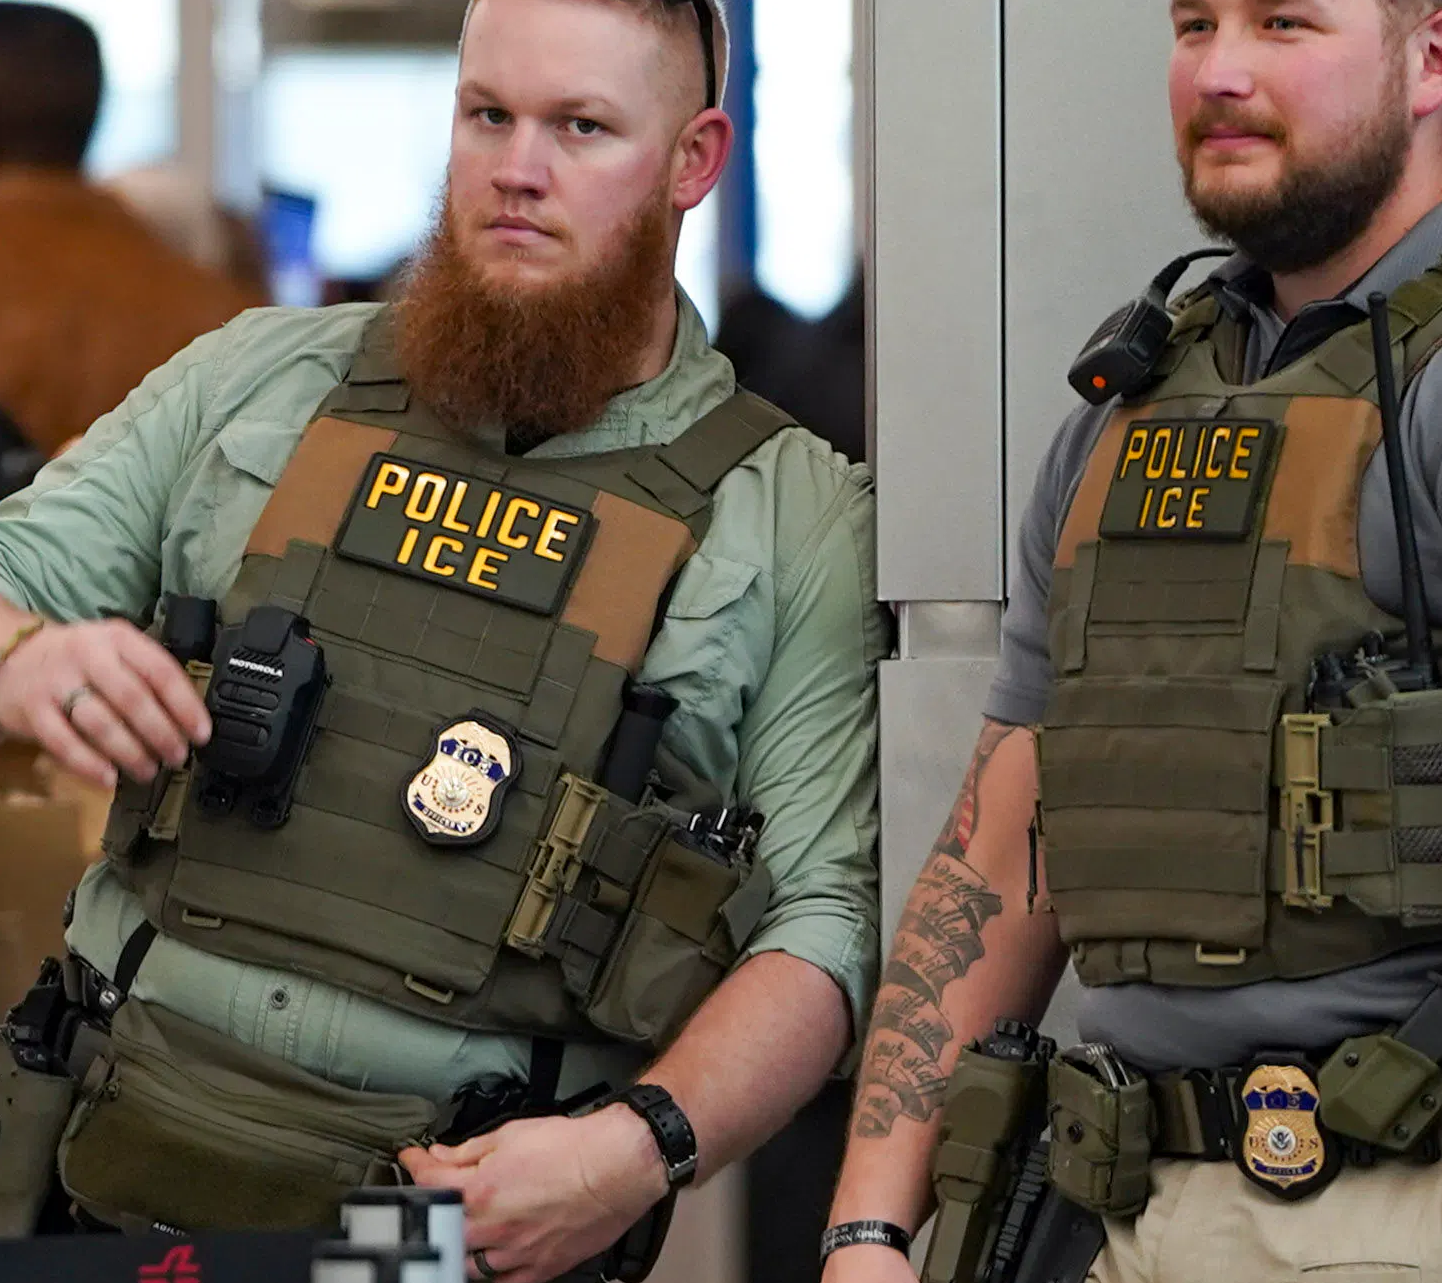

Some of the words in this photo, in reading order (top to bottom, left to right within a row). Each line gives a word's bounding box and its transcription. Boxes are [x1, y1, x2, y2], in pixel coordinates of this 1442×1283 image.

[1118, 427, 1259, 480] POLICE
[365, 462, 579, 562] POLICE
[1140, 487, 1210, 528] ICE
[397, 528, 509, 591] ICE
[228, 658, 283, 677] MOTOROLA
[452, 748, 492, 774] ICE
[420, 774, 433, 786] U
[474, 803, 485, 815] S
[1309, 1136, 1319, 1148] S
